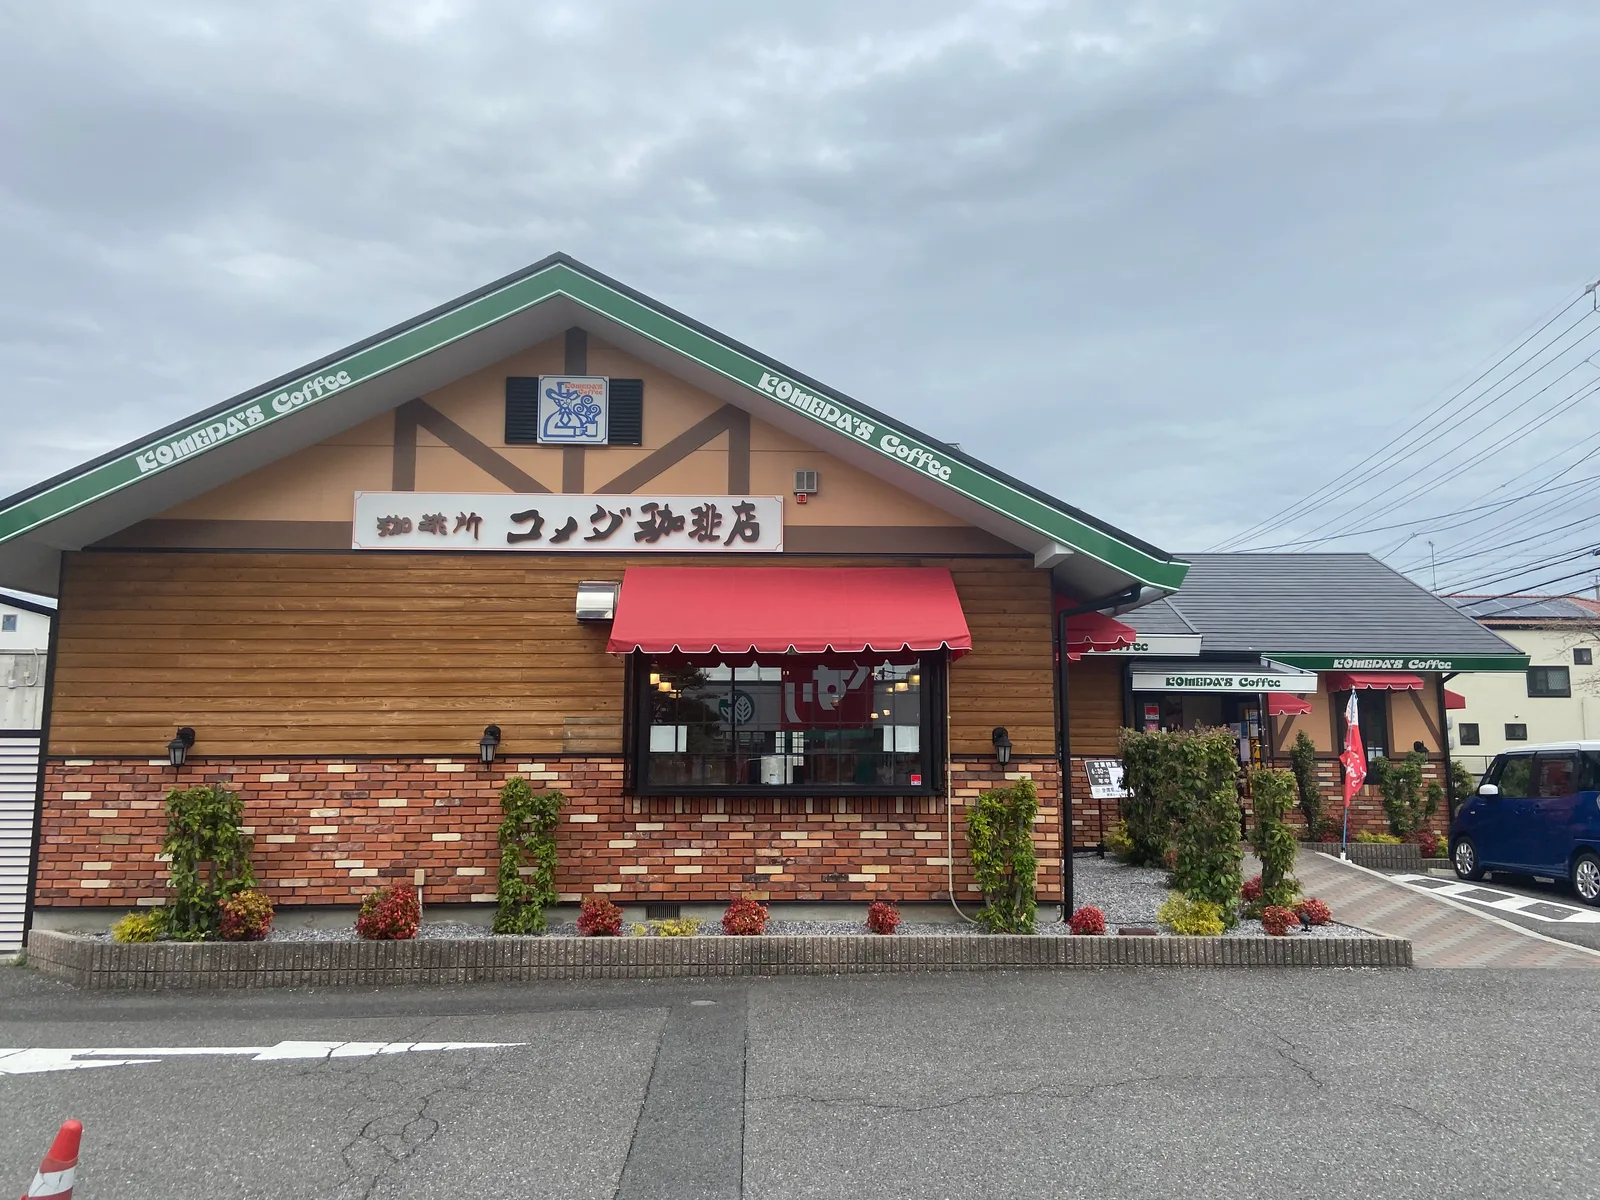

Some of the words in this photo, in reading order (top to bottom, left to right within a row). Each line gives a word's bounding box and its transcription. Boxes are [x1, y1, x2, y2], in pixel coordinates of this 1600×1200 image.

[135, 404, 265, 473] KOMEDA'S
[271, 370, 352, 413] Coffee
[757, 372, 876, 442] KOMEDA'S
[879, 434, 952, 481] Coffee
[506, 500, 761, 547] コメダ珈琲店
[1166, 677, 1233, 687] KOMEDA'S
[1238, 677, 1281, 688] Coffee
[1333, 659, 1404, 669] KOMEDA'S
[1407, 659, 1452, 670] Coffee
